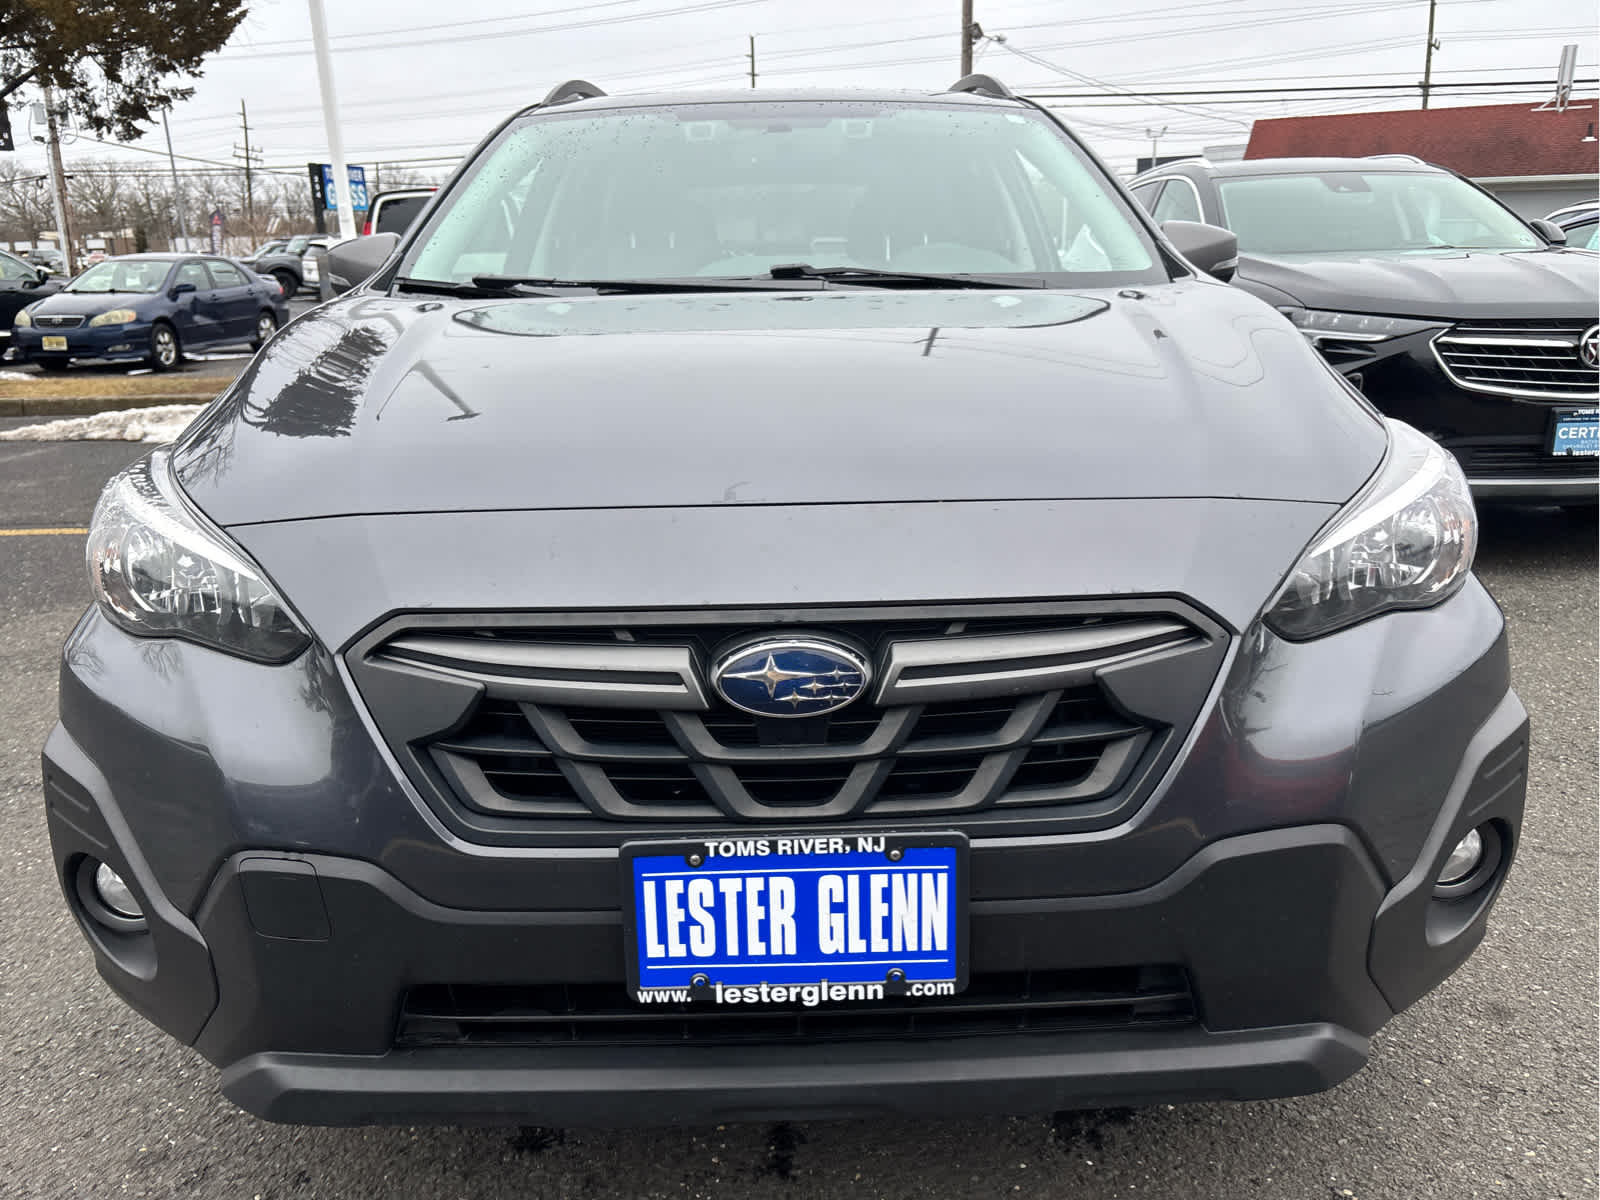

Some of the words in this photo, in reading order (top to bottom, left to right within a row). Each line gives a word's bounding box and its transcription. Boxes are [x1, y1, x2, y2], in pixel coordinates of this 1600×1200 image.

[327, 183, 367, 208] GSS
[706, 841, 770, 857] TOMS
[777, 838, 850, 856] RIVER,
[857, 837, 886, 854] NJ
[643, 876, 797, 959] LESTER
[817, 872, 949, 955] GLENN
[637, 988, 692, 1003] www.
[715, 981, 884, 1007] lesterglenn
[905, 981, 955, 997] .com
